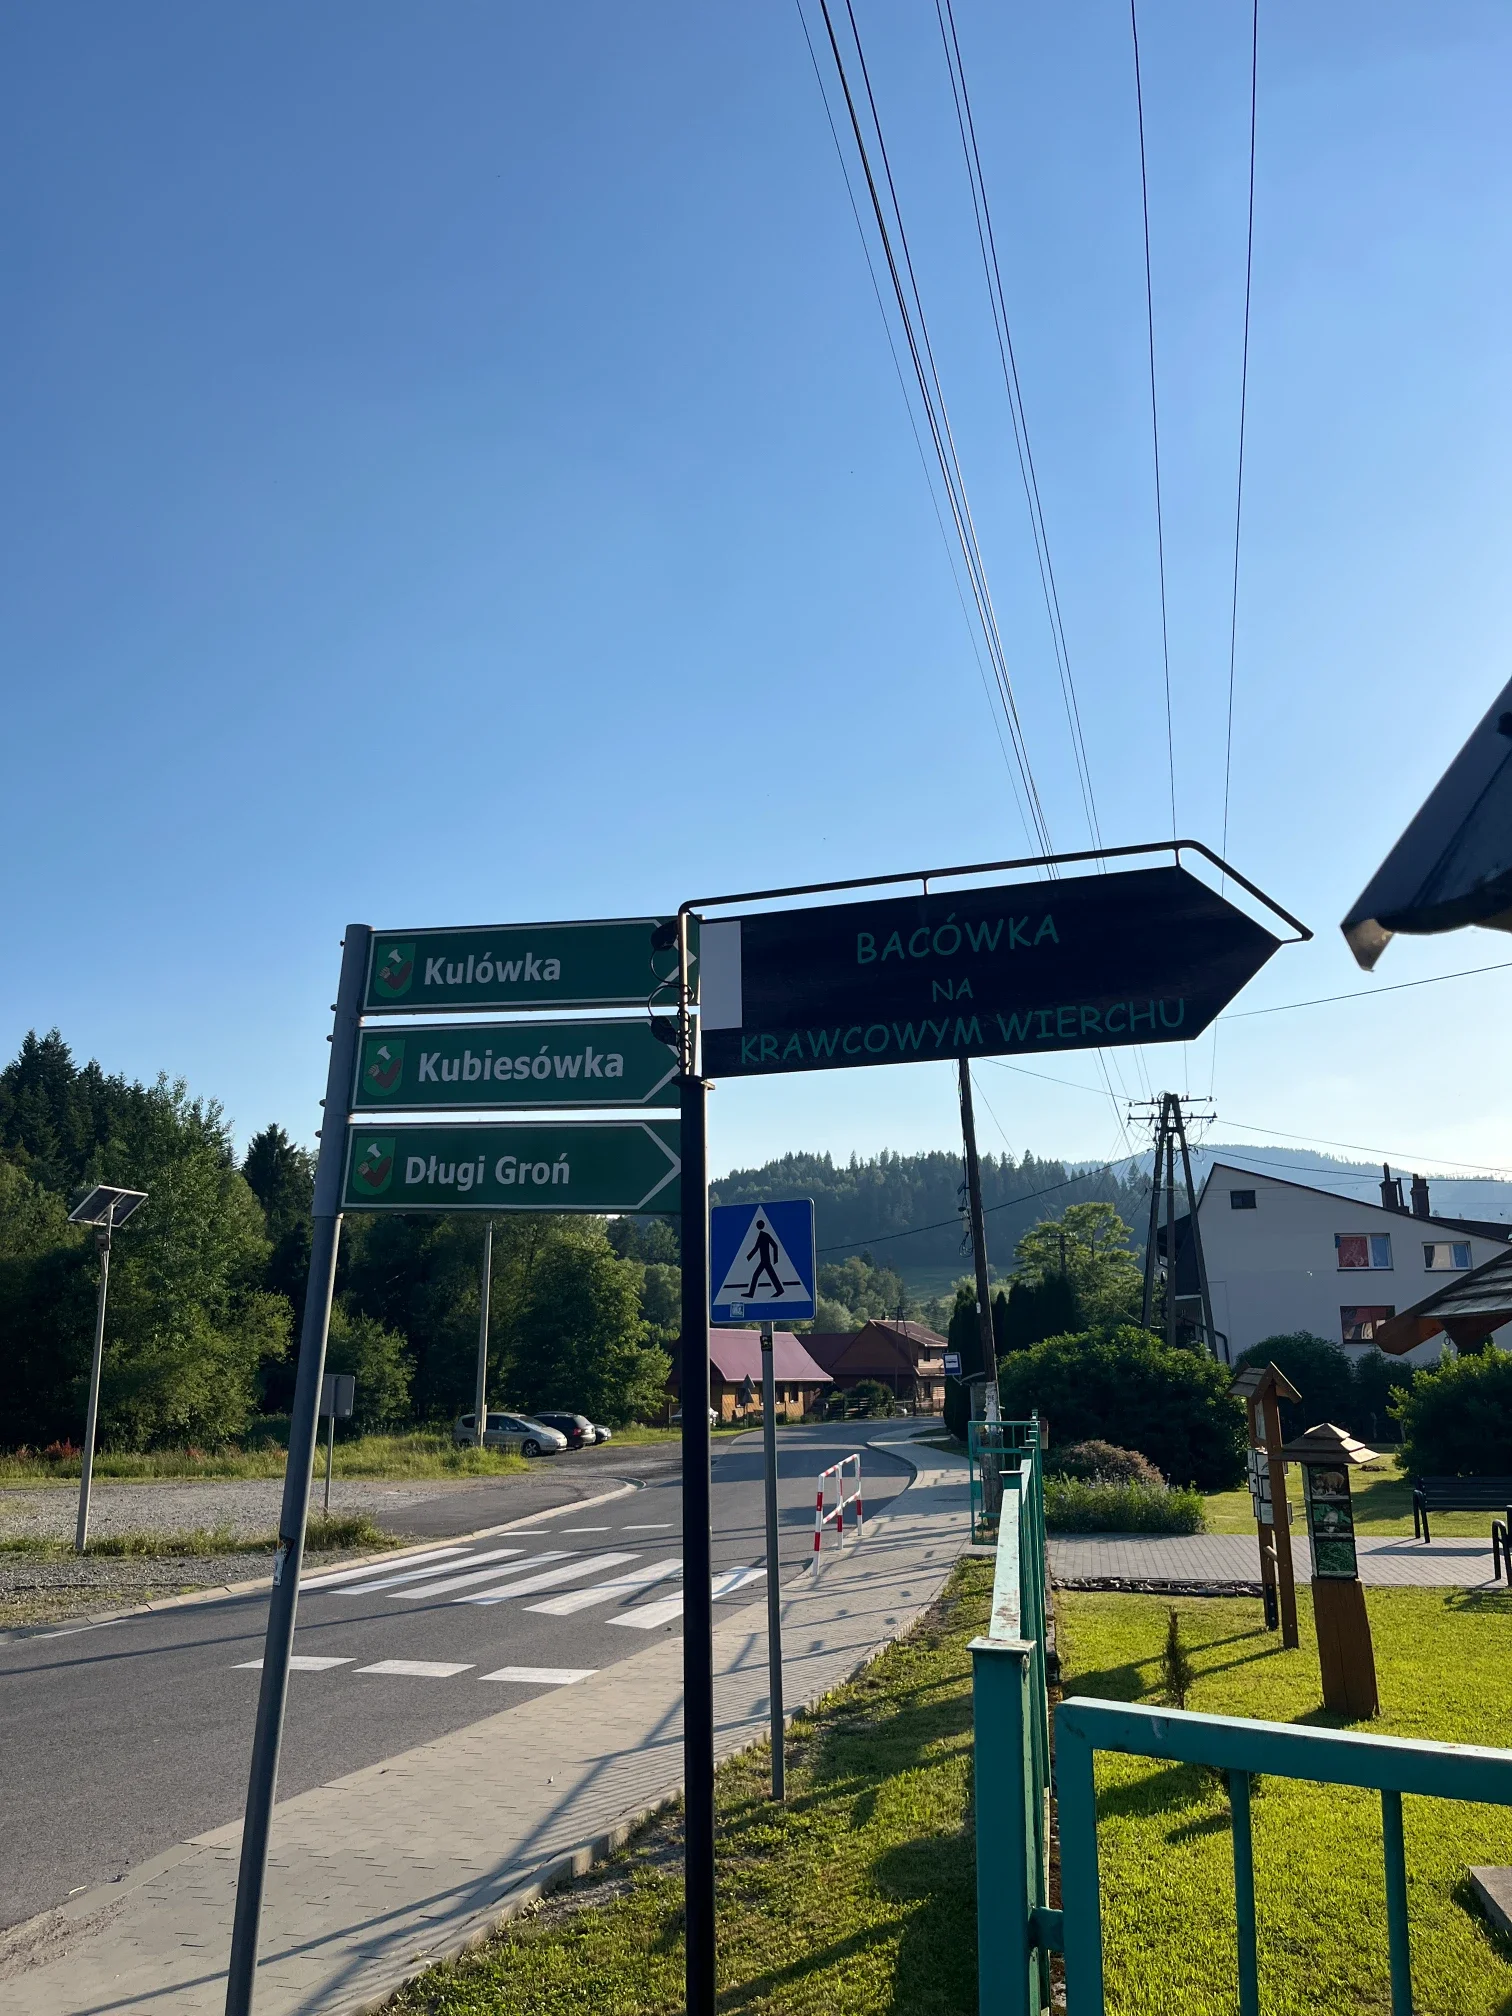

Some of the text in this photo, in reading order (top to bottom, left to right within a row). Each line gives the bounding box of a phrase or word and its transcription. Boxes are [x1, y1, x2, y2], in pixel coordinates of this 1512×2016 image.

[856, 913, 1060, 965] BACÓWKA
[424, 952, 561, 985] Kulówka
[931, 978, 974, 1002] NA
[740, 998, 1186, 1064] KRAWCOWYM WIERCHU
[418, 1046, 624, 1082] Kubiesówka
[405, 1153, 570, 1192] Długi Groń
